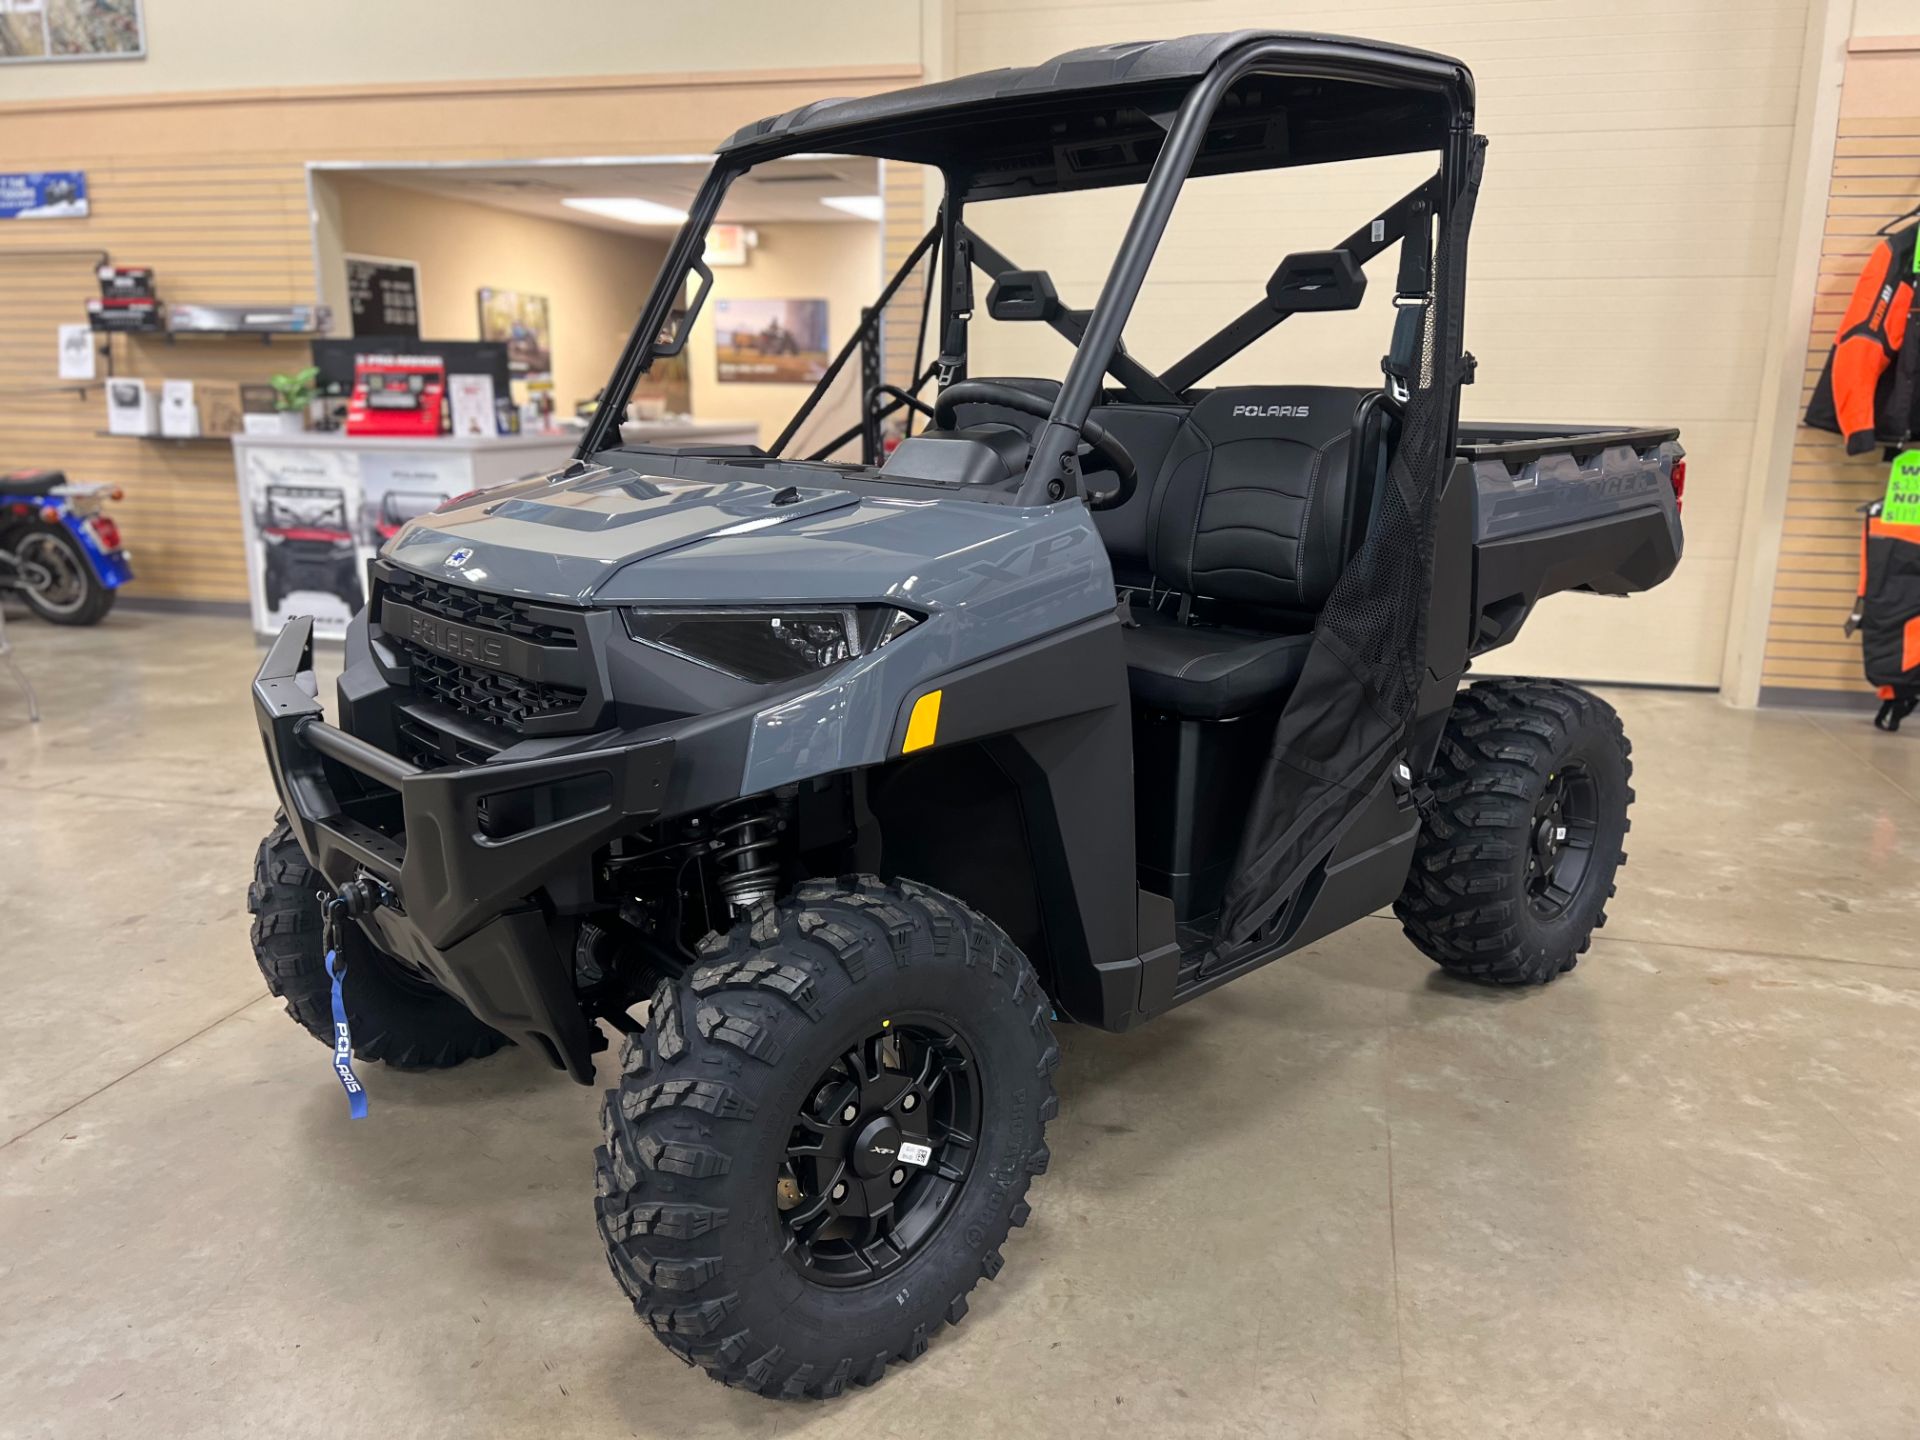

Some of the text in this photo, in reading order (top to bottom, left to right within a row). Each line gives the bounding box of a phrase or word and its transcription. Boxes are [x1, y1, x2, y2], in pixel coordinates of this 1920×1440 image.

[1232, 405, 1310, 417] POLARIS
[921, 524, 1094, 601] XP
[410, 616, 502, 666] POLARIS
[335, 1022, 362, 1093] POLARIS
